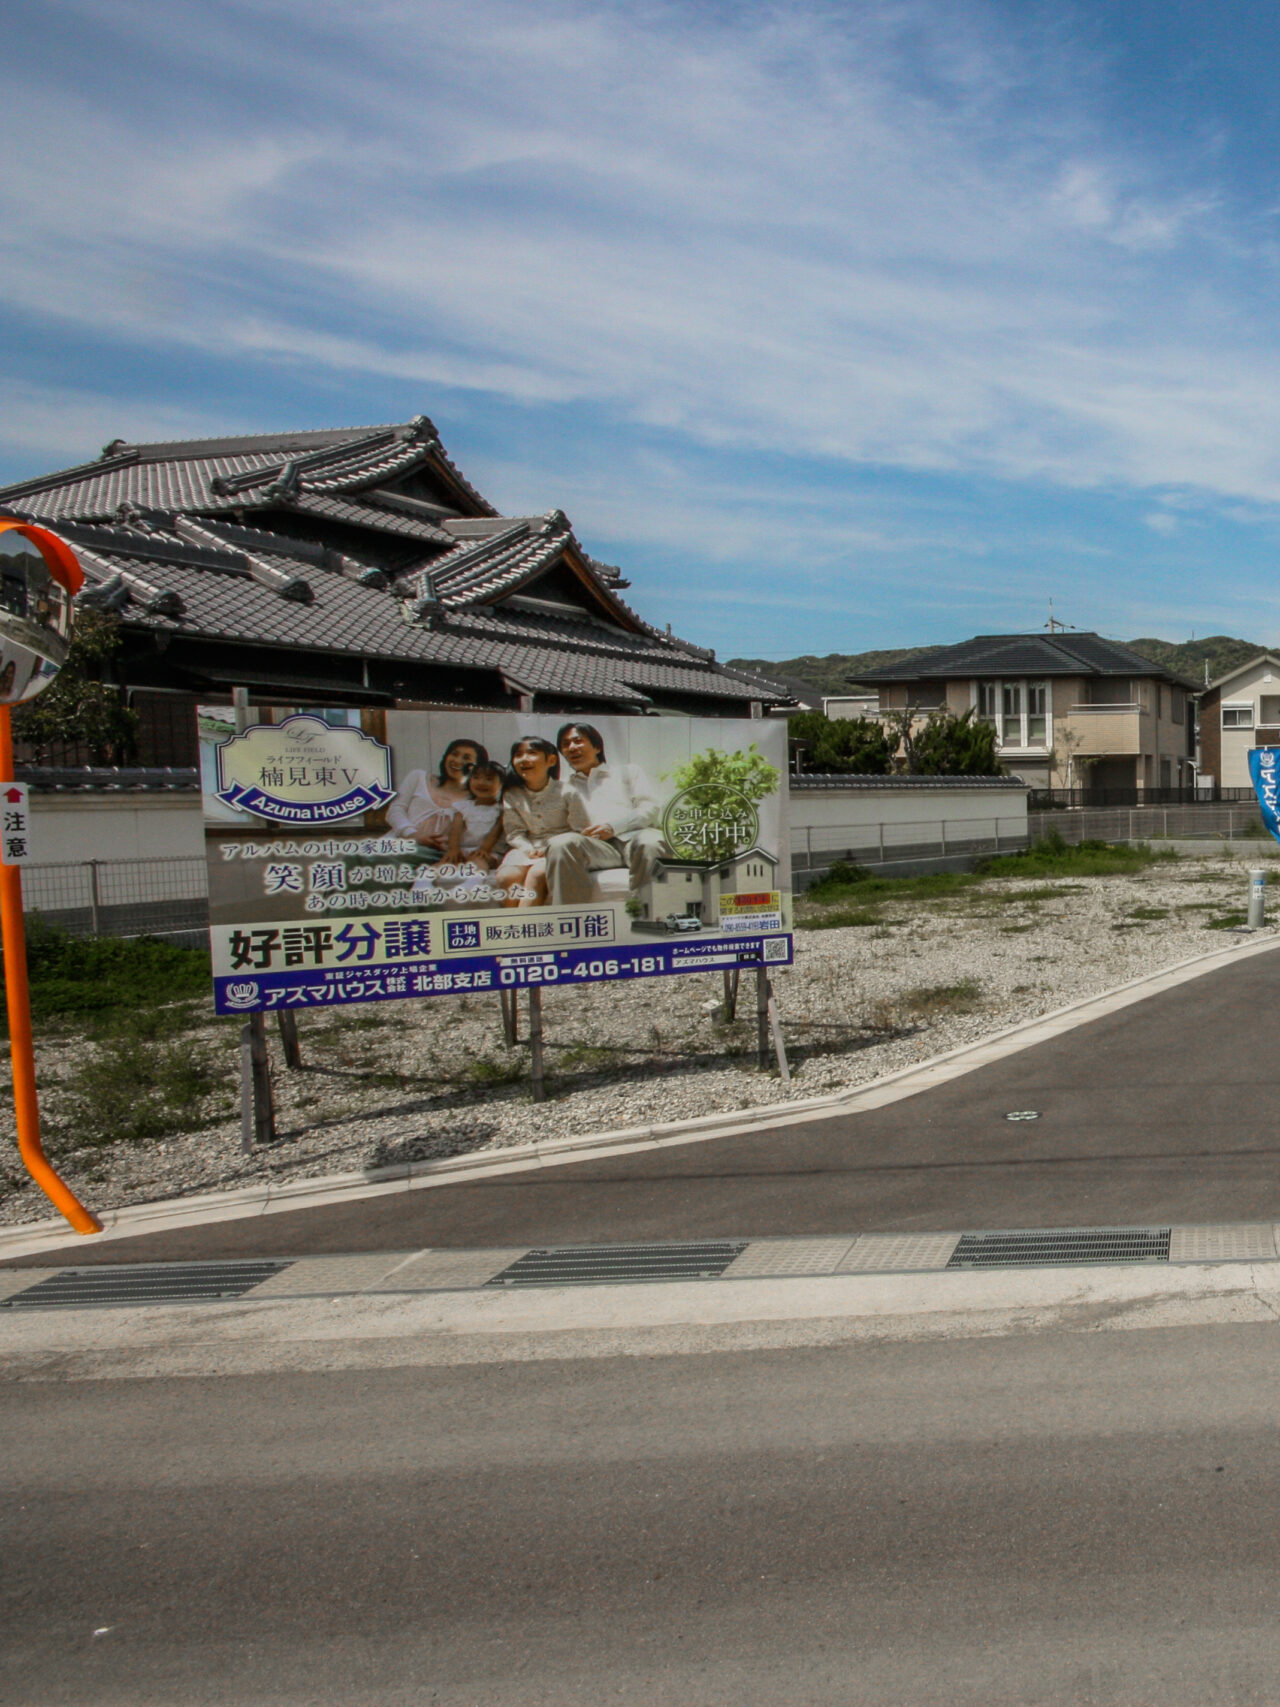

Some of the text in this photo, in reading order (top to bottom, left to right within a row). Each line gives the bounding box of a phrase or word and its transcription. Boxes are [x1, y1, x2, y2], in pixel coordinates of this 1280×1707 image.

[266, 755, 342, 764] ライフフィールド
[250, 795, 366, 819] Azuma House
[674, 808, 747, 819] お申し込み
[4, 811, 27, 857] 注意
[222, 839, 415, 857] アルバムの中の家族に
[451, 924, 476, 936] 土地
[229, 919, 431, 970] 好評分譲
[451, 936, 477, 947] のみ
[501, 956, 665, 985] 0120-406-181
[675, 957, 715, 966] アズマハウス
[413, 970, 492, 992] 北部支店
[264, 979, 386, 1006] アズマハウス
